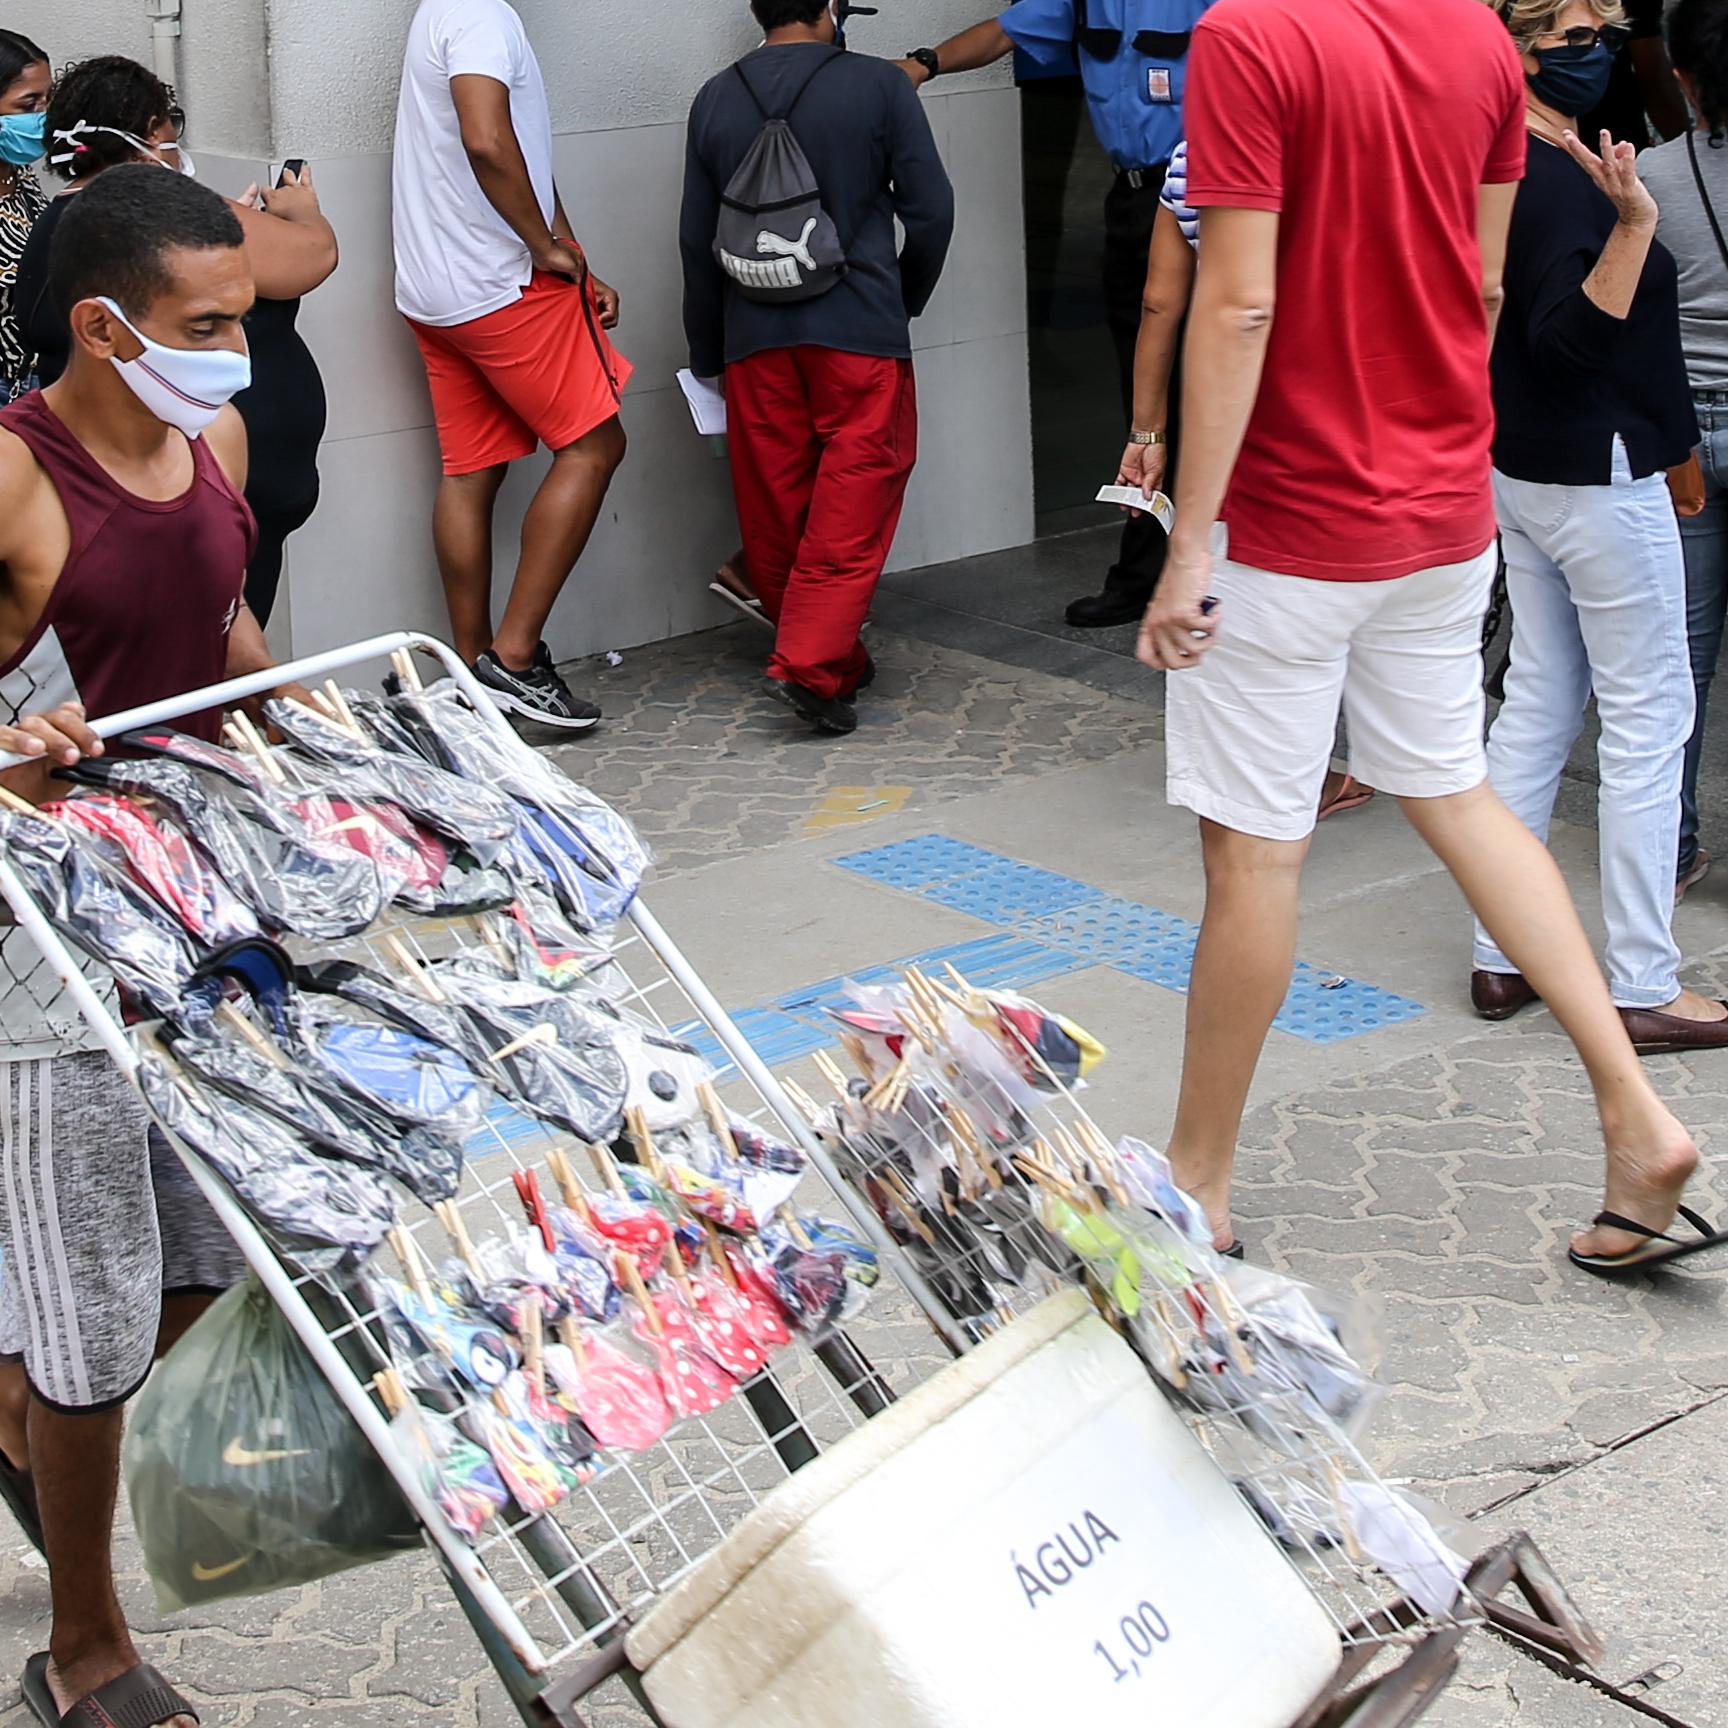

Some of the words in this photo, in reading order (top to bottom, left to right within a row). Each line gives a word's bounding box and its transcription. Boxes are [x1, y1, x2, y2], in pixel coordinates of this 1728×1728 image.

[720, 248, 803, 288] PUMA
[1010, 1509, 1121, 1609] ÁGUA
[1094, 1600, 1170, 1682] 1,00
